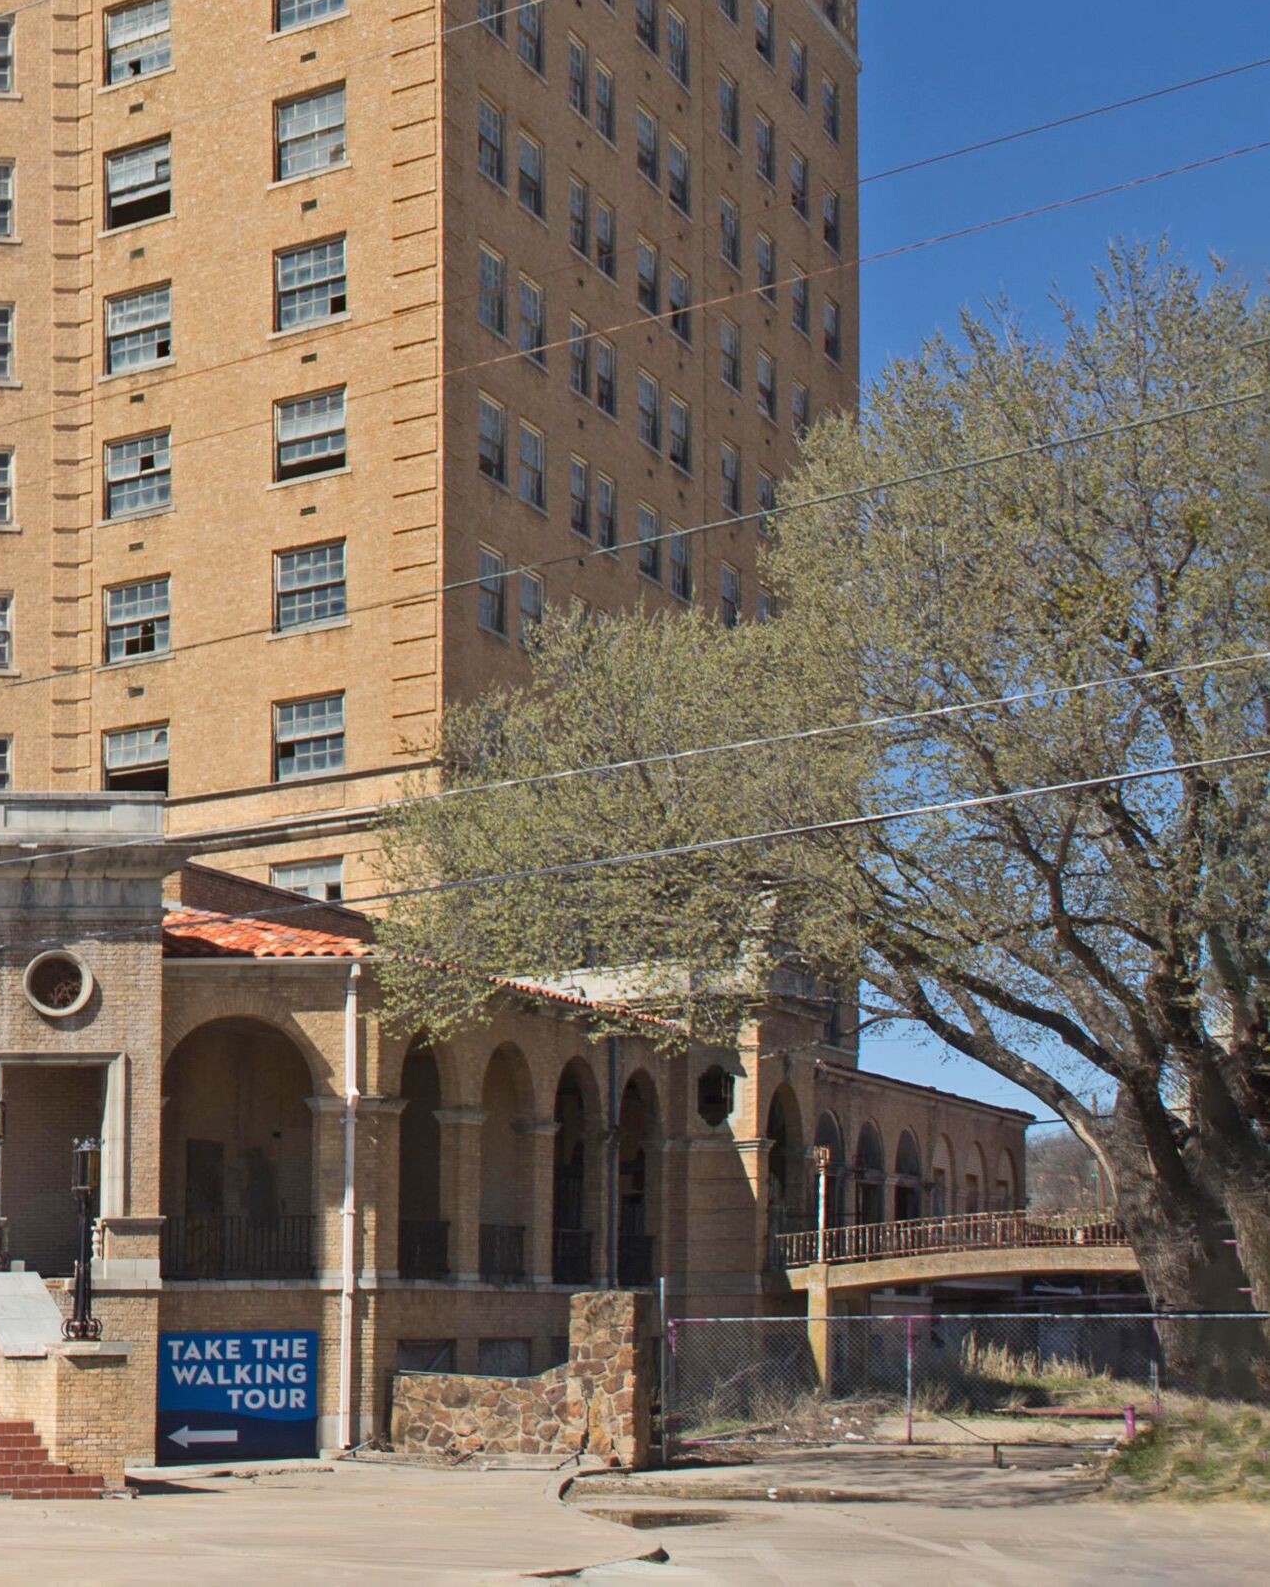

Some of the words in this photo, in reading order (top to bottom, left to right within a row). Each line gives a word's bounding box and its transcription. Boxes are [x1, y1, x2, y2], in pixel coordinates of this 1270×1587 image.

[168, 1340, 242, 1360] TAKE
[252, 1338, 308, 1359] THE
[172, 1363, 307, 1386] WALKING
[227, 1388, 306, 1410] TOUR
